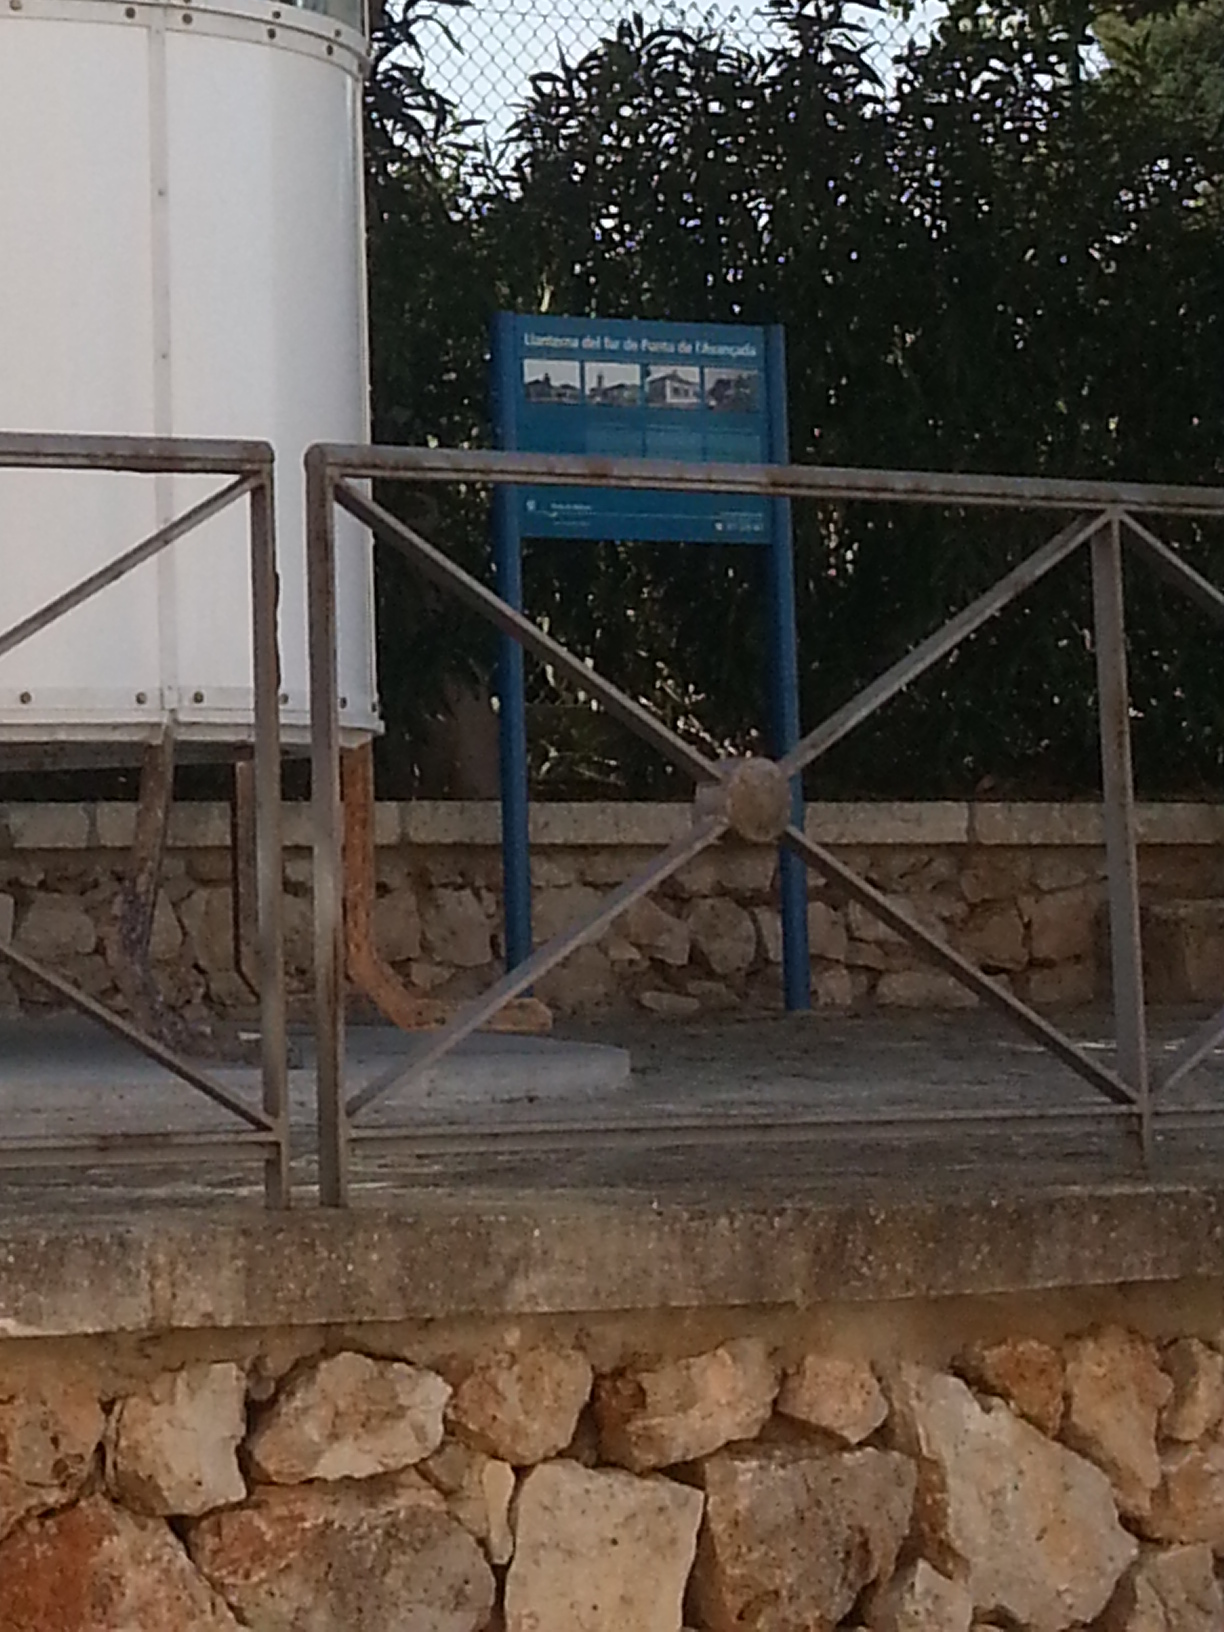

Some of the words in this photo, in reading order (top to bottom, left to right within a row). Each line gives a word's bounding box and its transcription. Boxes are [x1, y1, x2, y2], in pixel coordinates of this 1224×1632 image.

[581, 335, 601, 349] del
[623, 337, 639, 351] de
[678, 340, 693, 354] de
